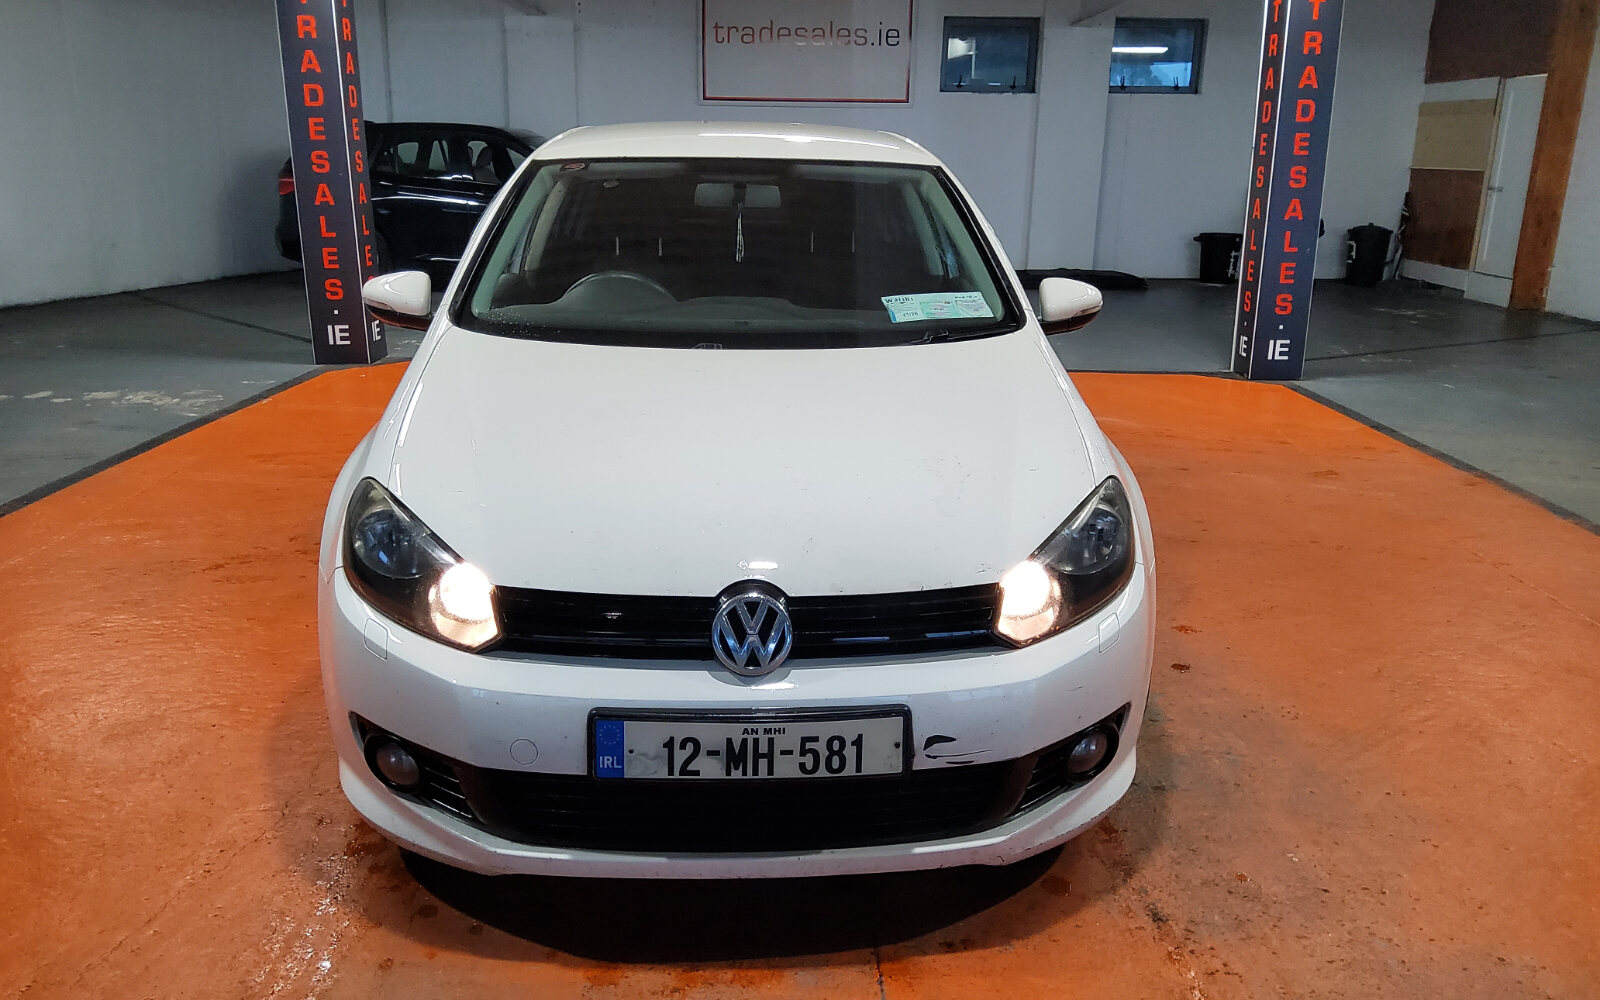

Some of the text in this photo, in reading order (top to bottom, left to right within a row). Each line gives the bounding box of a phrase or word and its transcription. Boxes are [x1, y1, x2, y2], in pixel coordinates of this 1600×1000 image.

[713, 19, 901, 47] tradesales.ie
[297, 0, 351, 346] RADESALES.IE
[741, 727, 786, 736] AN MHI
[600, 755, 623, 769] IRL
[662, 733, 864, 778] 12-MH-581
